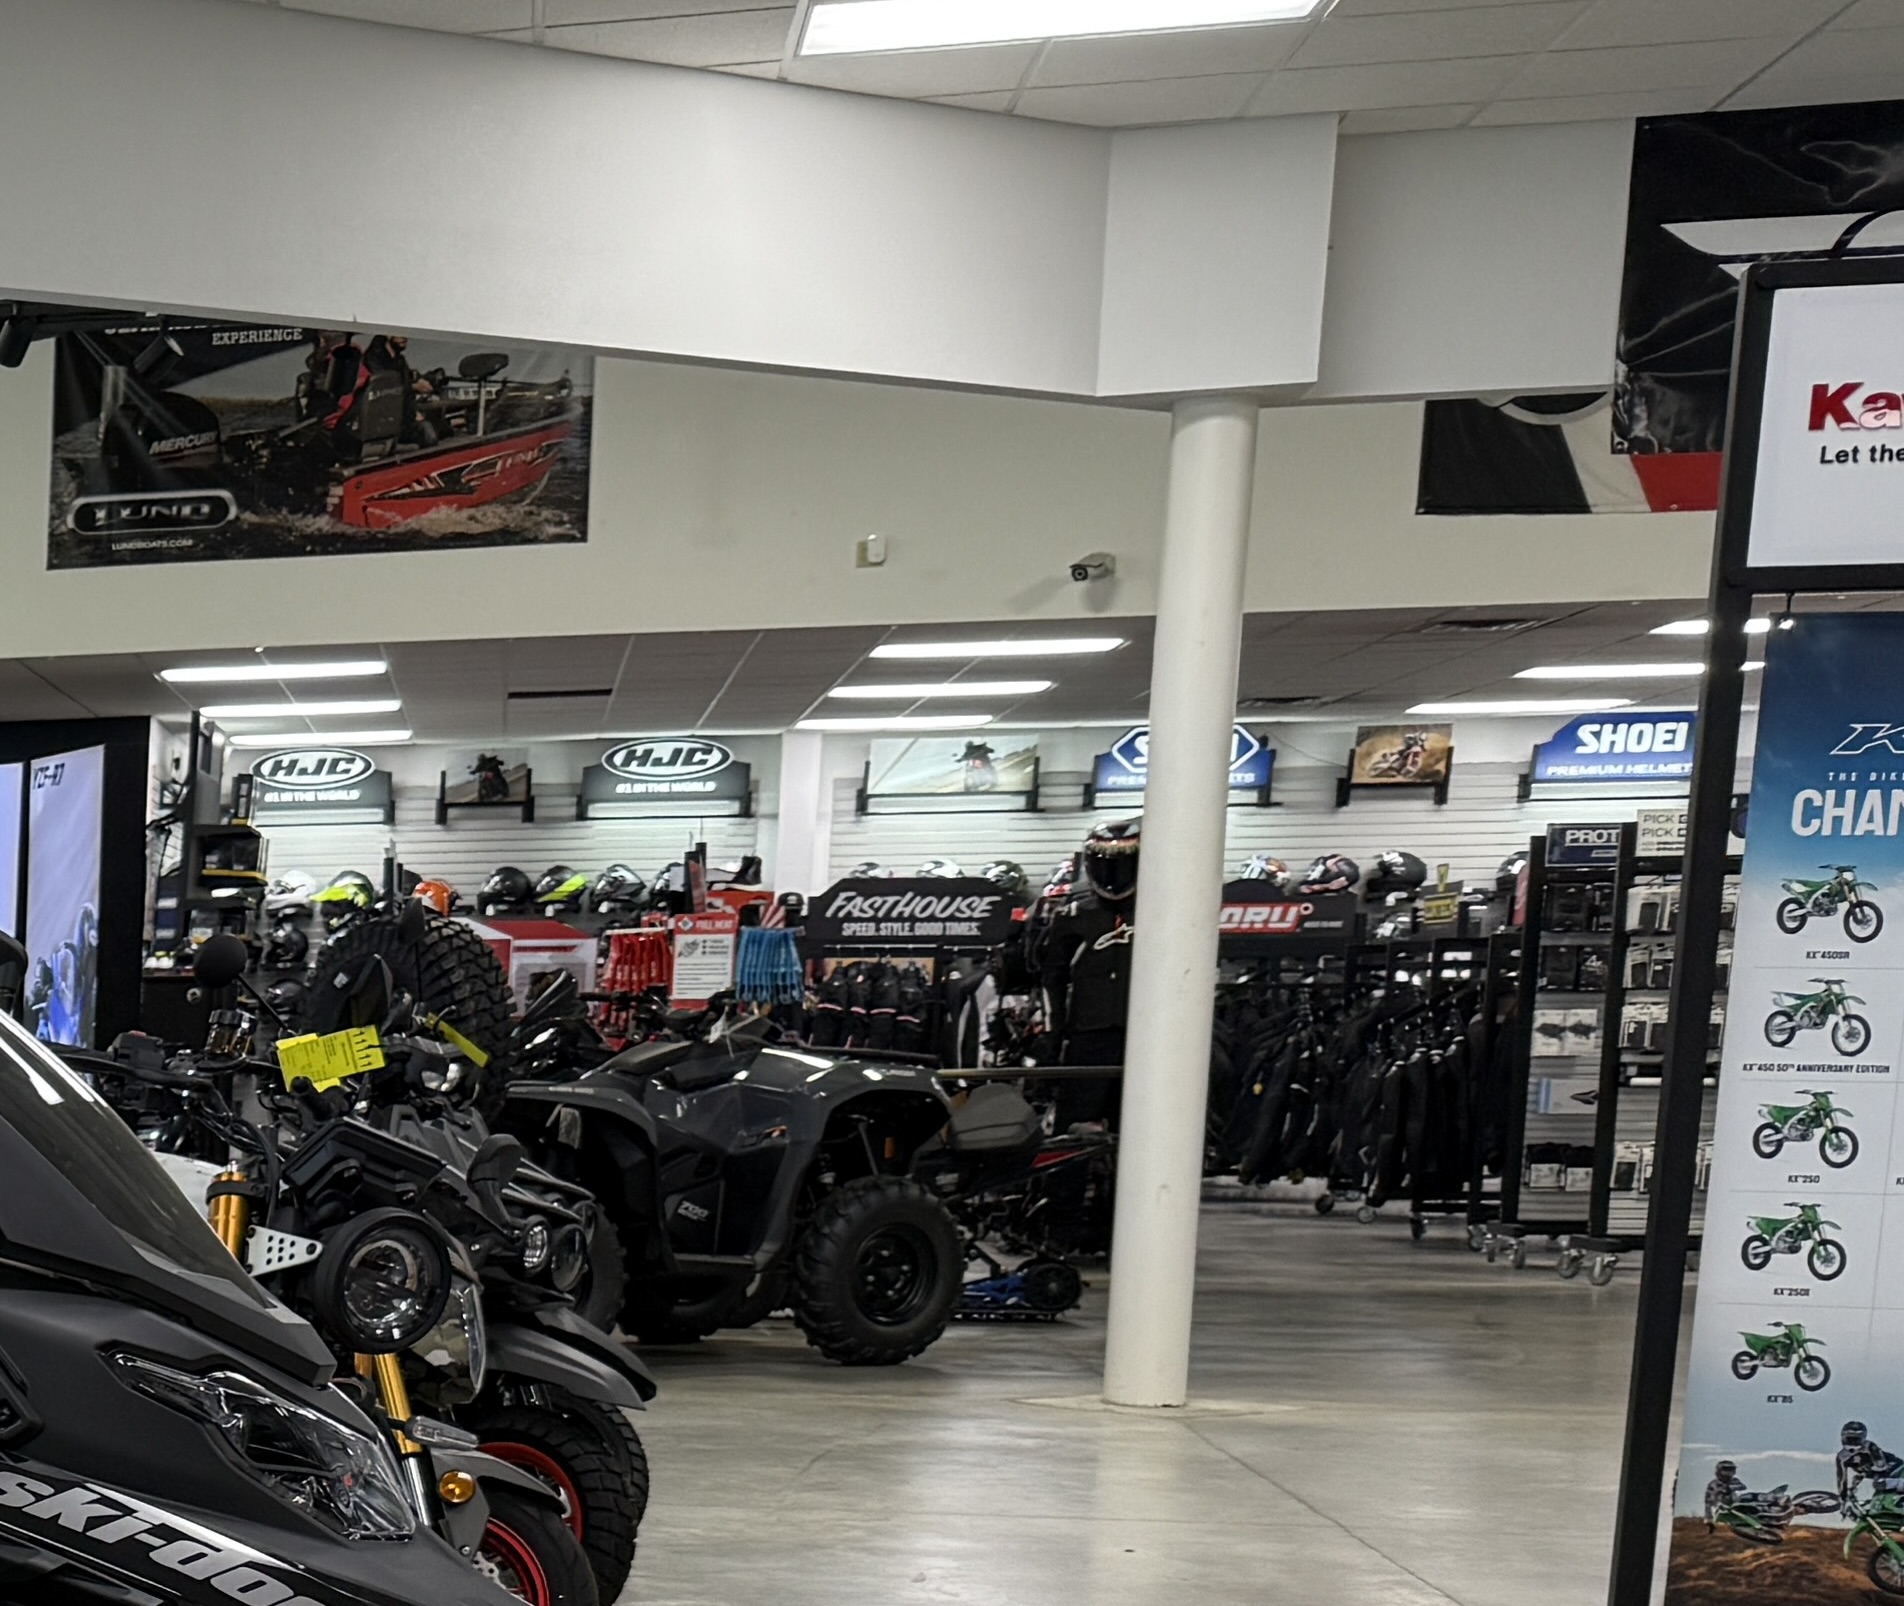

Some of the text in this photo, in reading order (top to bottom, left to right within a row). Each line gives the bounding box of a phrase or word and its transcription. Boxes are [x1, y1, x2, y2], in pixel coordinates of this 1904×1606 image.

[211, 328, 303, 346] EXPERIENCE
[1808, 381, 1904, 432] Ka
[1819, 444, 1861, 465] Let
[1574, 721, 1690, 754] SHOEI
[618, 746, 717, 768] HJC
[267, 756, 358, 778] HJC
[1546, 763, 1625, 777] PREMIUM
[1828, 771, 1904, 782] THE BIK
[1643, 814, 1675, 824] PICK
[1641, 828, 1673, 838] PICK
[824, 891, 1003, 919] FASTHOUSE
[914, 922, 943, 937] GOOD
[1796, 1063, 1854, 1073] ANNIVERSARY
[1855, 1064, 1890, 1074] EDITION
